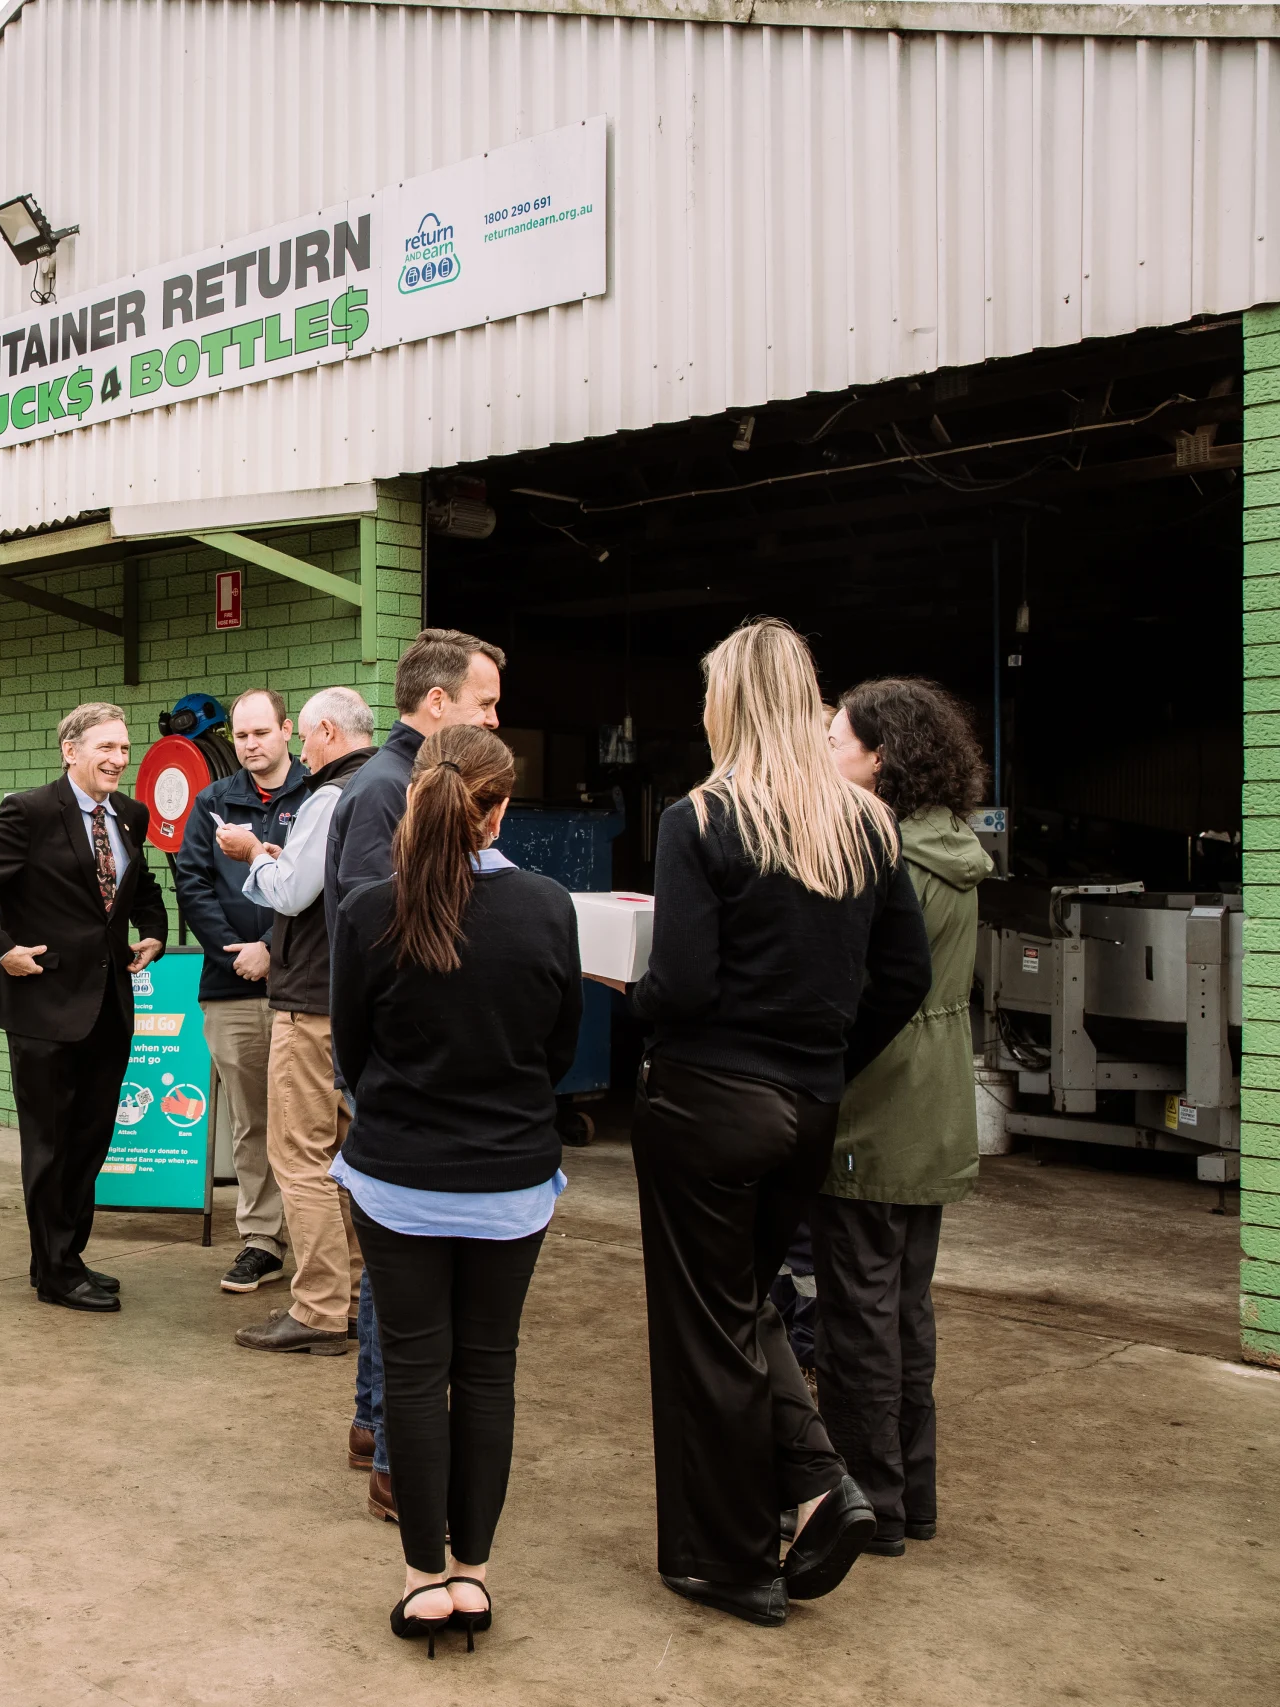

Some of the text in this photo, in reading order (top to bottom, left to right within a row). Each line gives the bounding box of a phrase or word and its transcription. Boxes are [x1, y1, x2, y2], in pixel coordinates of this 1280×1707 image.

[484, 195, 551, 225] 1800 290 691
[484, 204, 593, 243] returnandearn.org.au
[405, 225, 454, 252] return
[404, 241, 454, 263] AND earn
[162, 213, 371, 330] RETURN
[100, 365, 122, 404] 4
[157, 1016, 176, 1031] Go
[128, 1055, 161, 1065] and go
[134, 1044, 180, 1053] when you
[138, 1165, 155, 1173] here.
